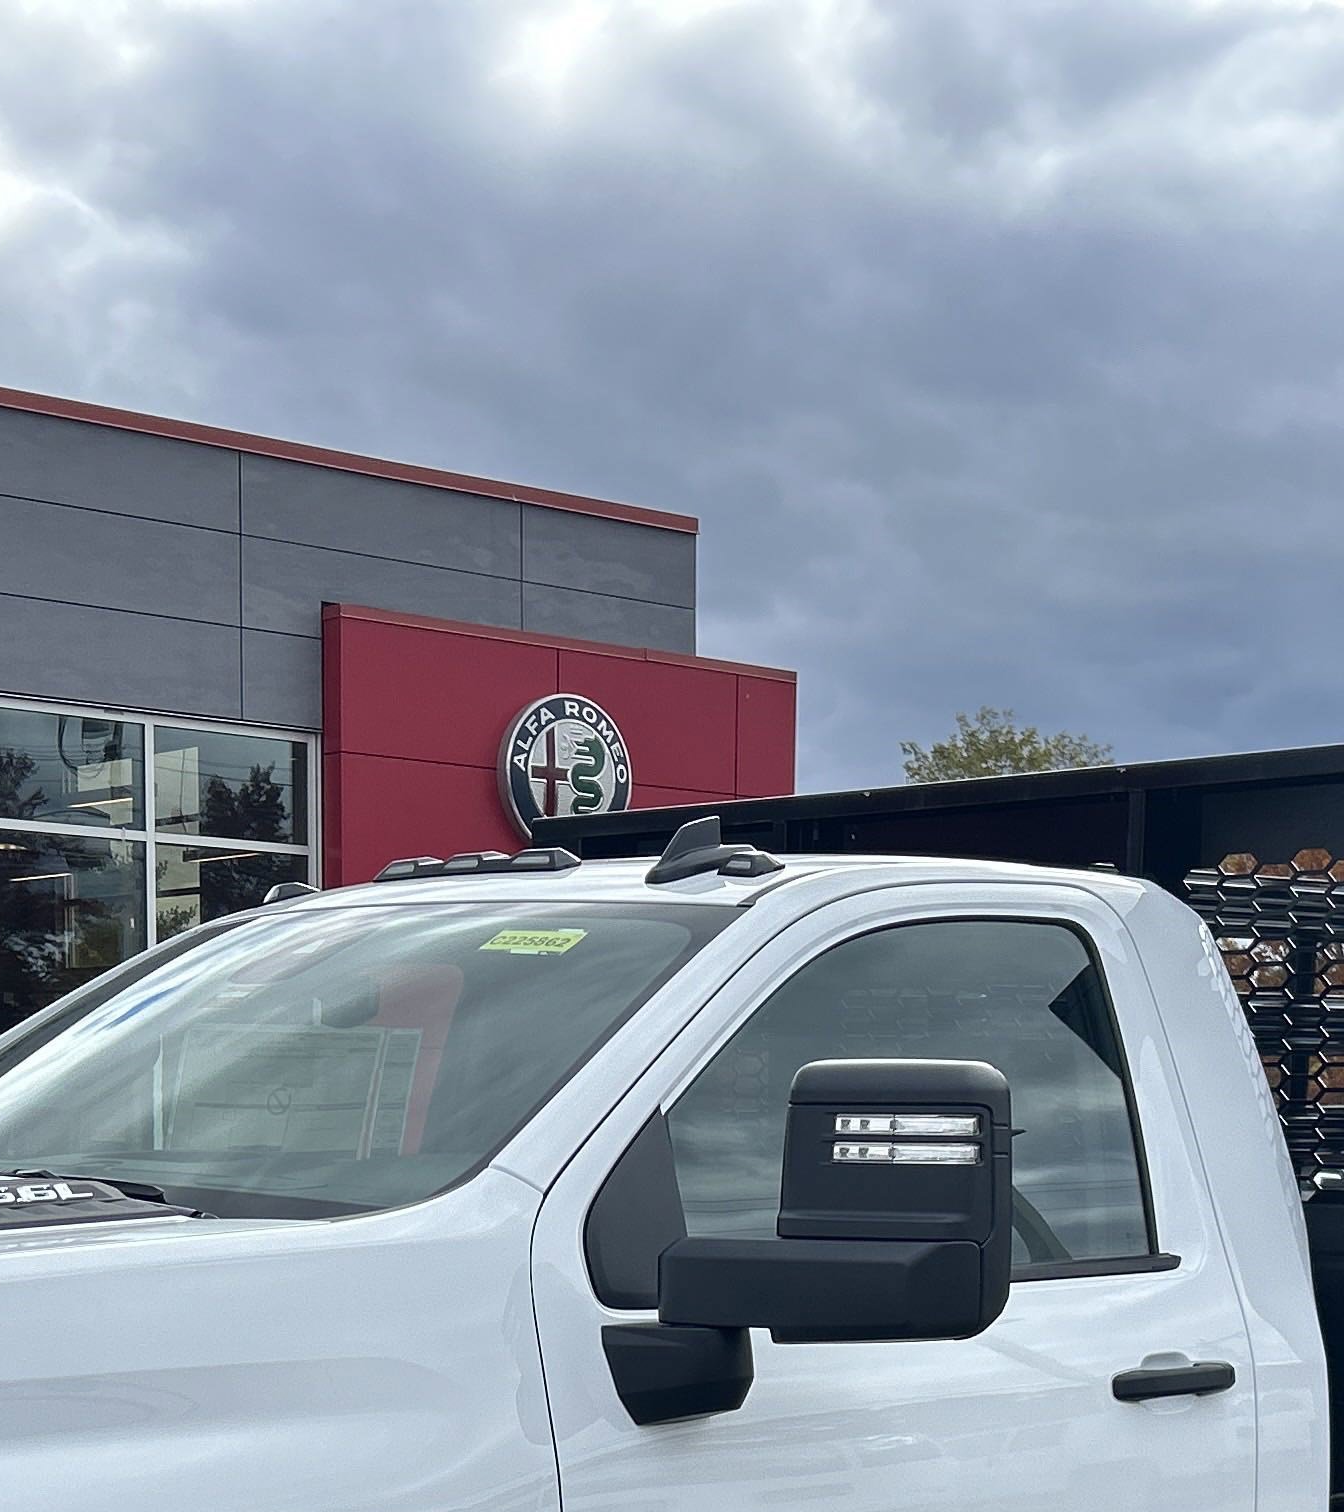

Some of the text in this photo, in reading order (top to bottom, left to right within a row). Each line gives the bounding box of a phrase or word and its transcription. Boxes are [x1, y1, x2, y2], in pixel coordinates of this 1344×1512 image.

[513, 700, 628, 784] ALFA ROMEO
[489, 935, 572, 948] C225862
